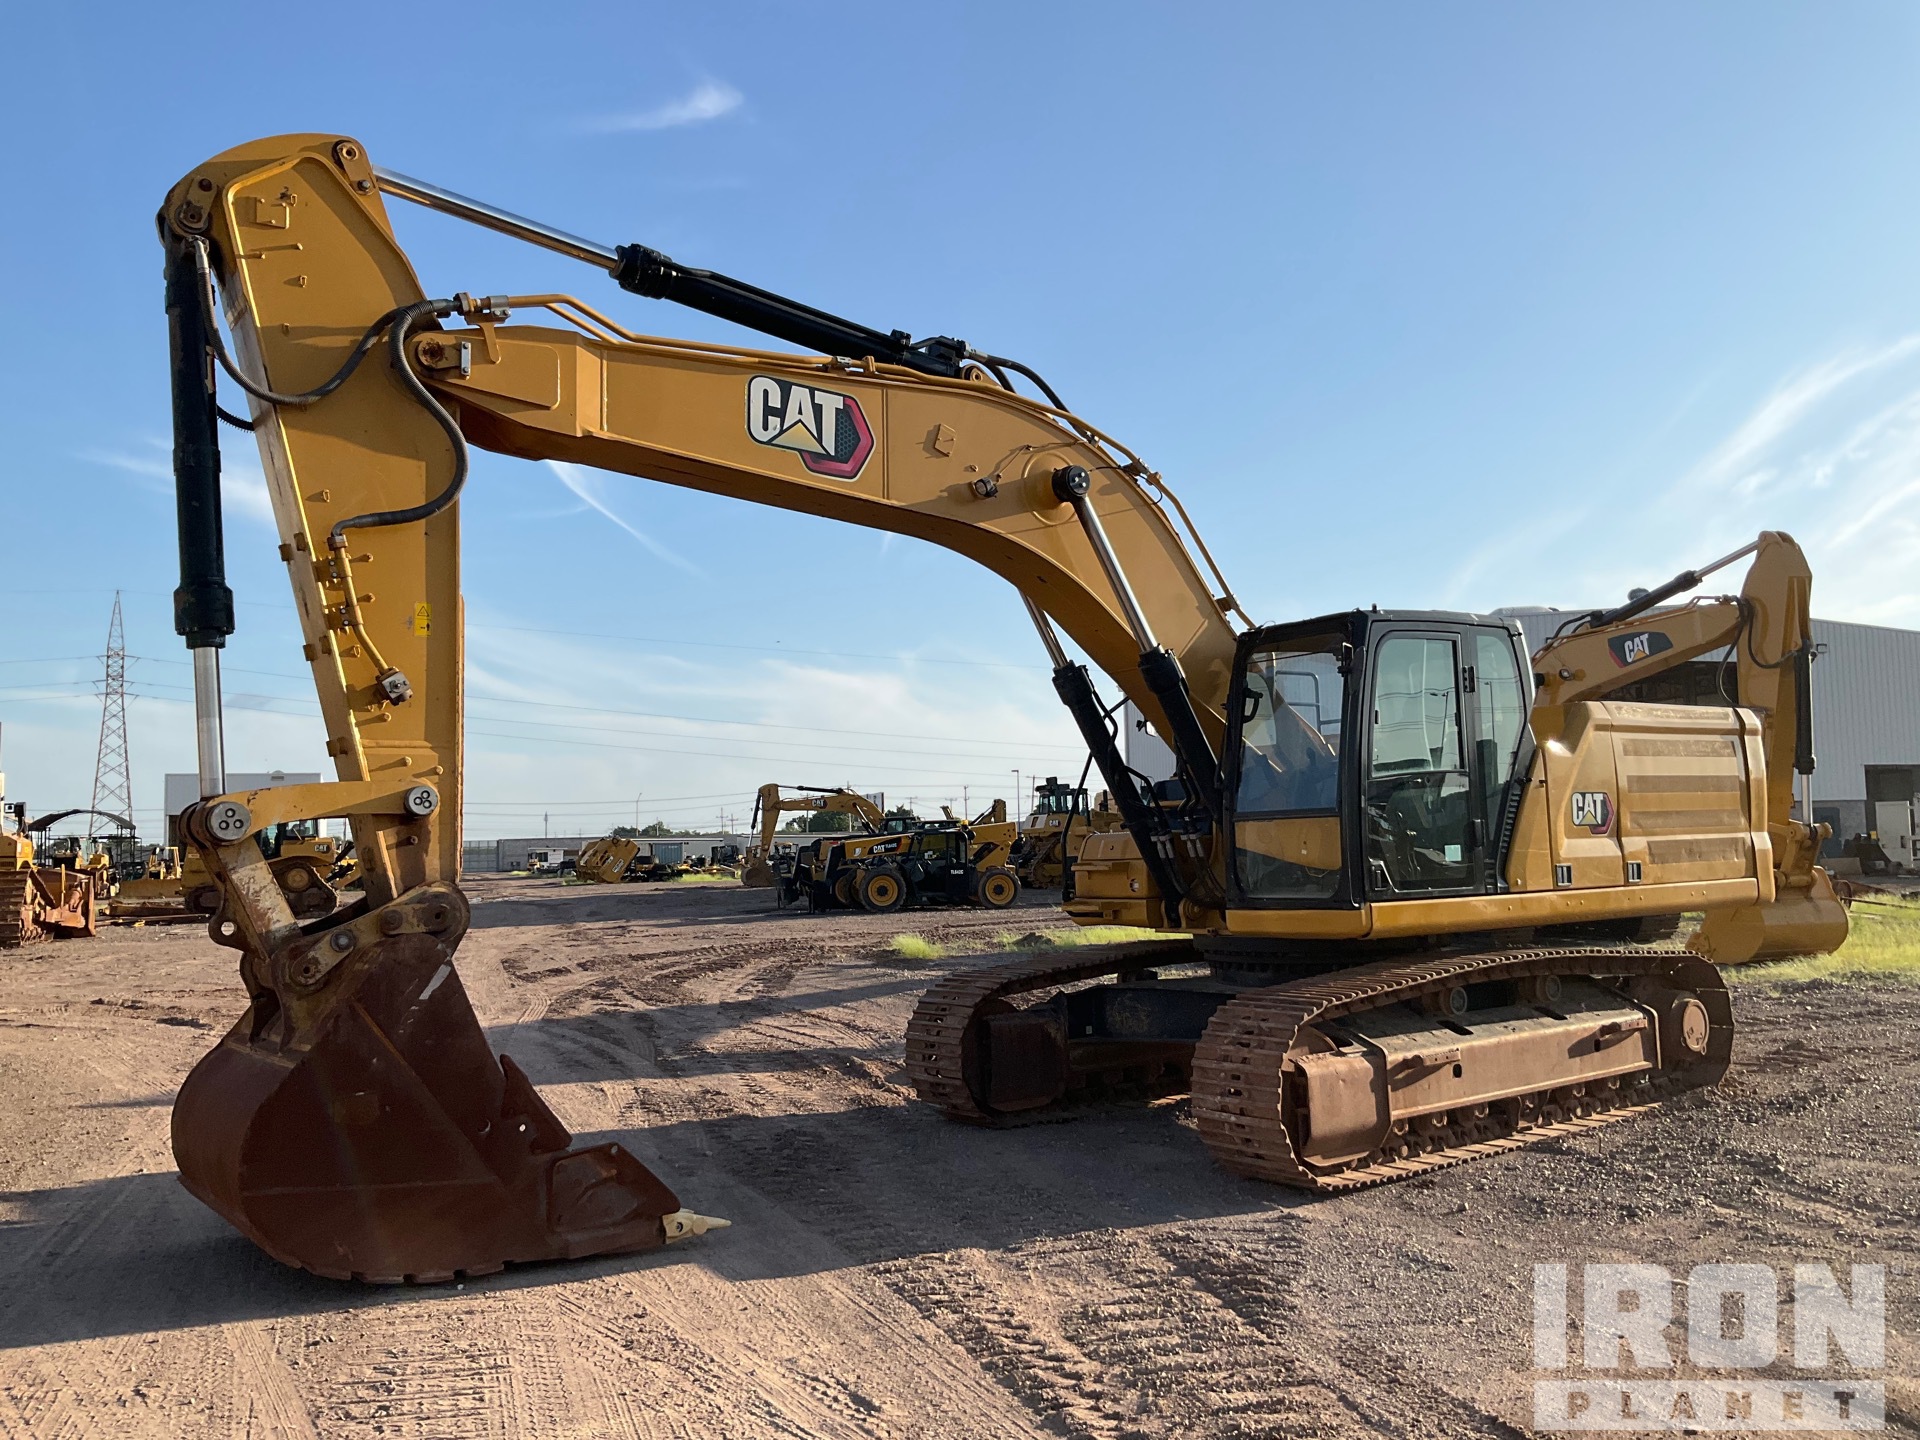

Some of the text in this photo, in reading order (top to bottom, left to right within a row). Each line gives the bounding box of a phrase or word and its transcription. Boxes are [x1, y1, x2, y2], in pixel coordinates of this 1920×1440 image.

[750, 376, 844, 456] CAT
[1624, 632, 1649, 663] CAT
[1572, 792, 1603, 825] CAT
[873, 844, 885, 854] CAT
